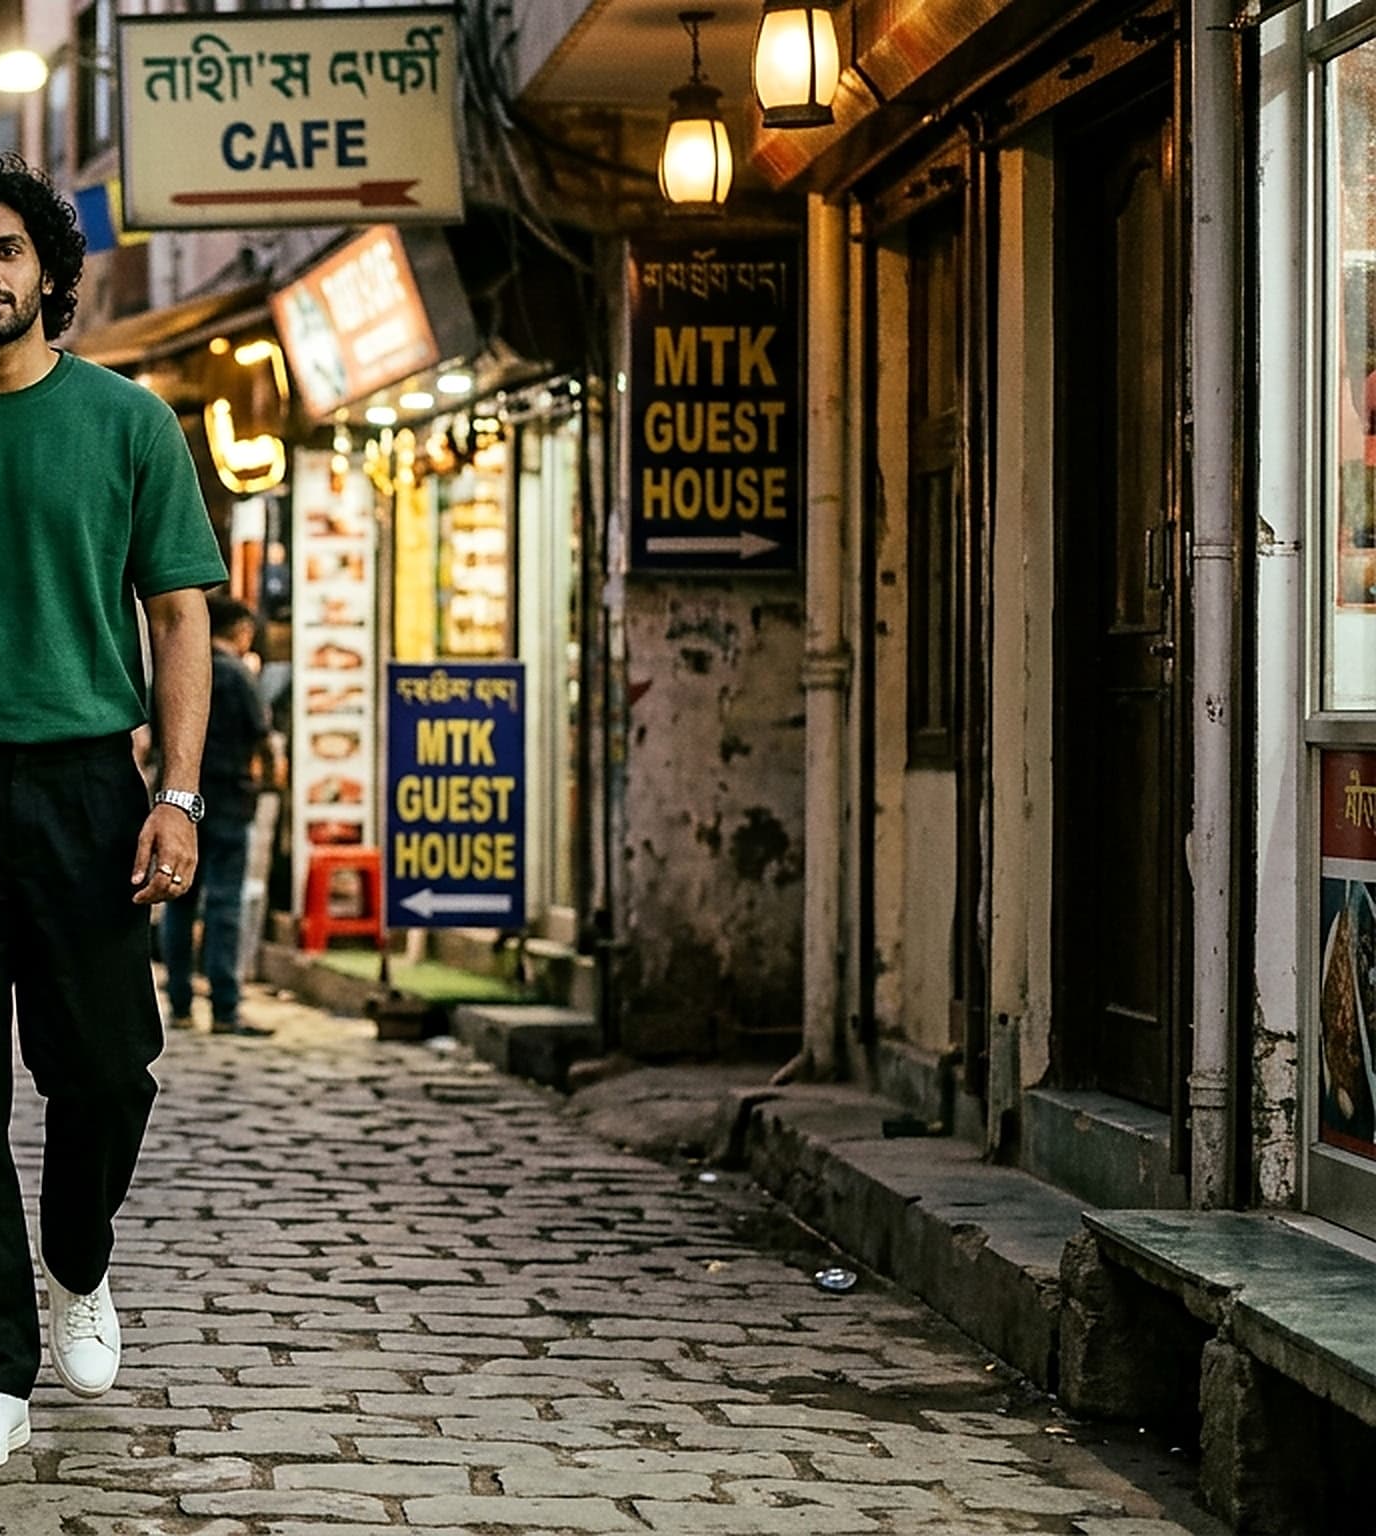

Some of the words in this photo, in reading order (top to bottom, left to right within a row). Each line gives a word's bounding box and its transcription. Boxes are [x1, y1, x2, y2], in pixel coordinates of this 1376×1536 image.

[221, 120, 368, 171] CAFE
[654, 326, 777, 387] MTK
[644, 401, 786, 454] GUEST
[642, 467, 787, 519] HOUSE
[417, 718, 496, 766] MTK
[396, 774, 515, 824] GUEST
[395, 832, 516, 880] HOUSE
